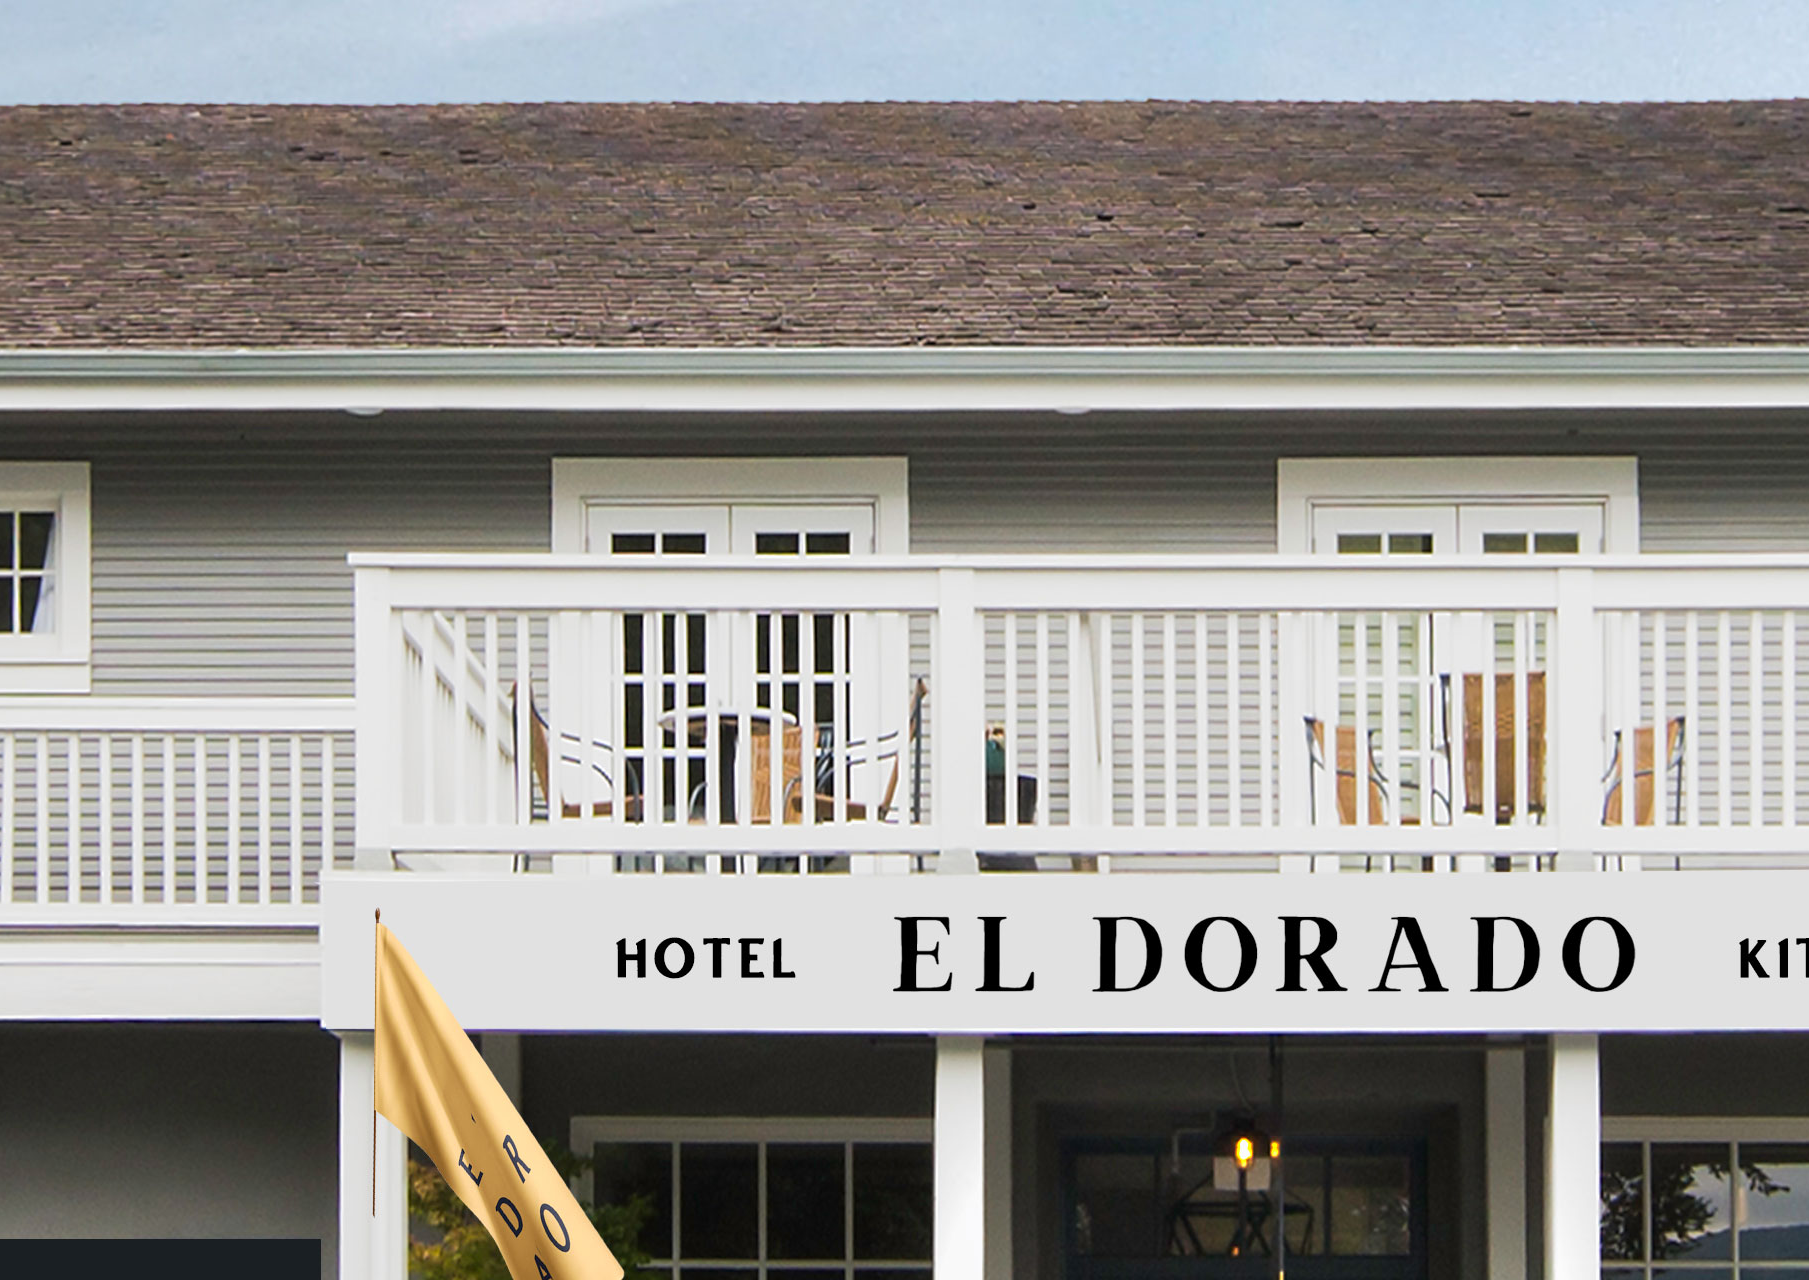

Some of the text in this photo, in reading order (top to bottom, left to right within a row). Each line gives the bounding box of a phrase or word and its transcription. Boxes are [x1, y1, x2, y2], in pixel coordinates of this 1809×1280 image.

[614, 936, 797, 980] HOTEL
[892, 915, 1036, 993] EL
[1092, 915, 1637, 994] DORADO
